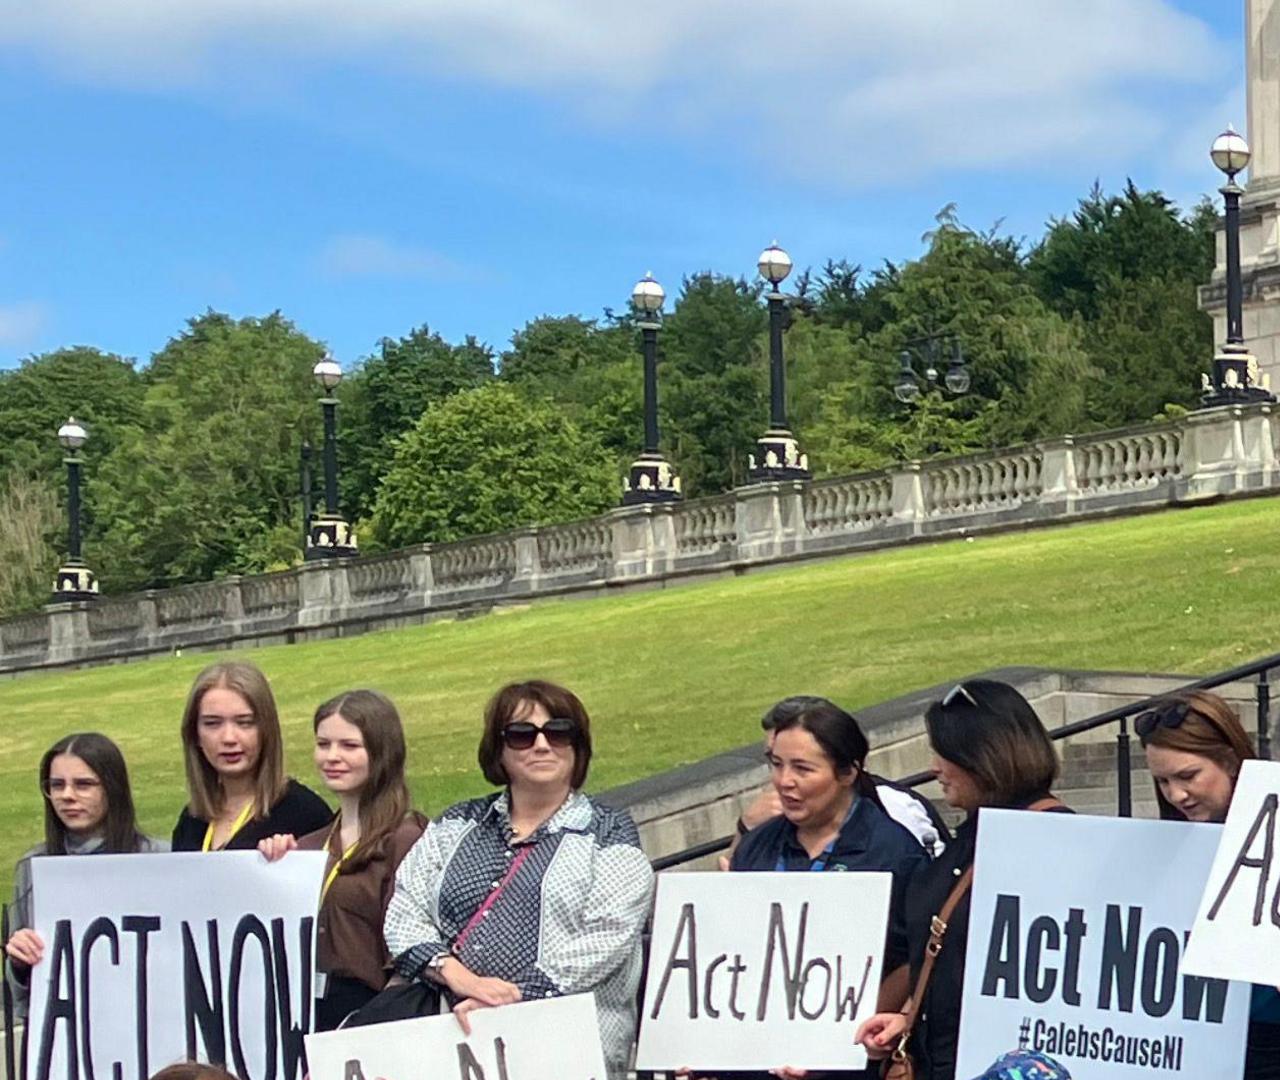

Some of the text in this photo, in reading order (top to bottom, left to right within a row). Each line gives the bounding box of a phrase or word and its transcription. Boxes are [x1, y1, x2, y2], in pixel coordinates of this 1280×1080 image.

[651, 902, 873, 1022] Act Now
[981, 894, 1087, 1007] Act
[1019, 1017, 1183, 1071] #CalebsCauseNI
